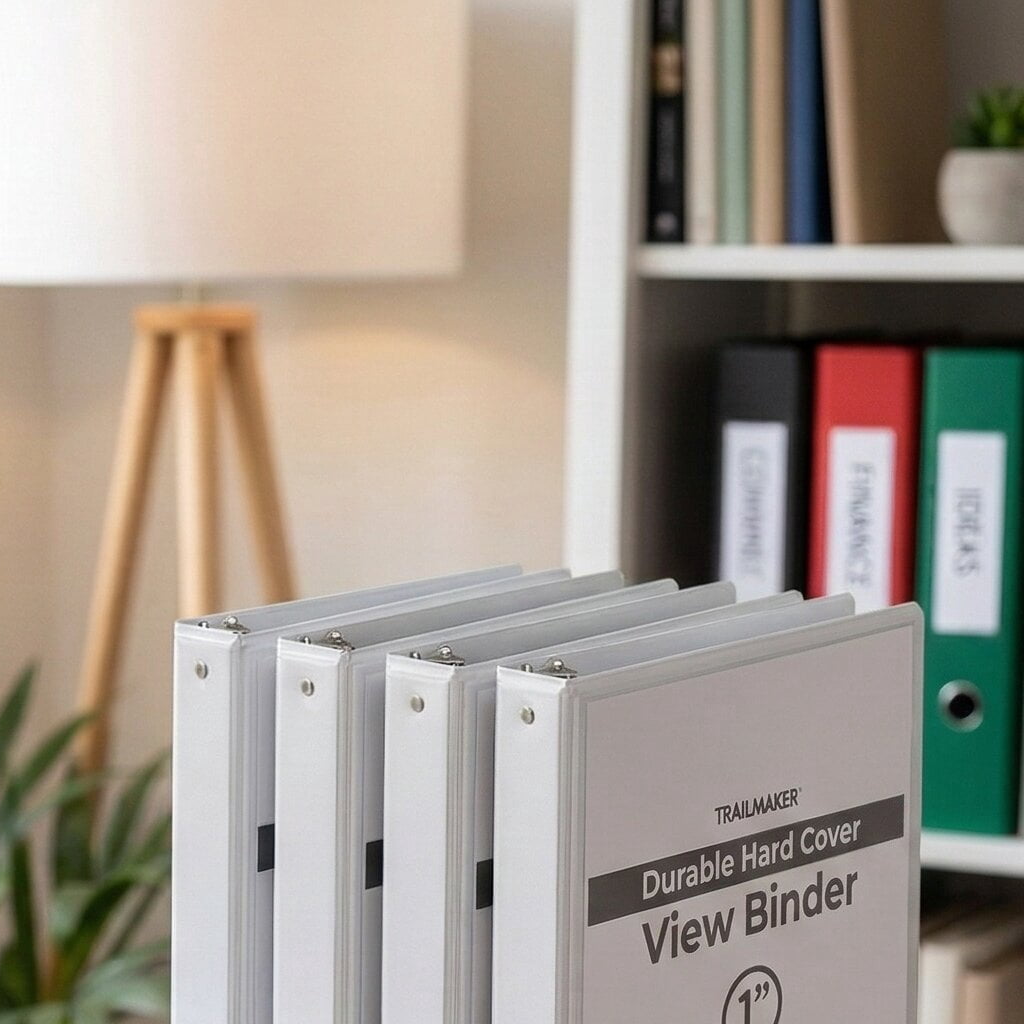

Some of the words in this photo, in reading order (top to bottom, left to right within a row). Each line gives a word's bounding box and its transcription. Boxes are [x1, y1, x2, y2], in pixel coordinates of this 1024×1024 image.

[714, 788, 799, 825] TRAILMAKER
[642, 850, 735, 900] Durable
[741, 831, 794, 873] Hard
[800, 818, 861, 854] Cover
[642, 907, 736, 965] View
[745, 871, 858, 936] Binder
